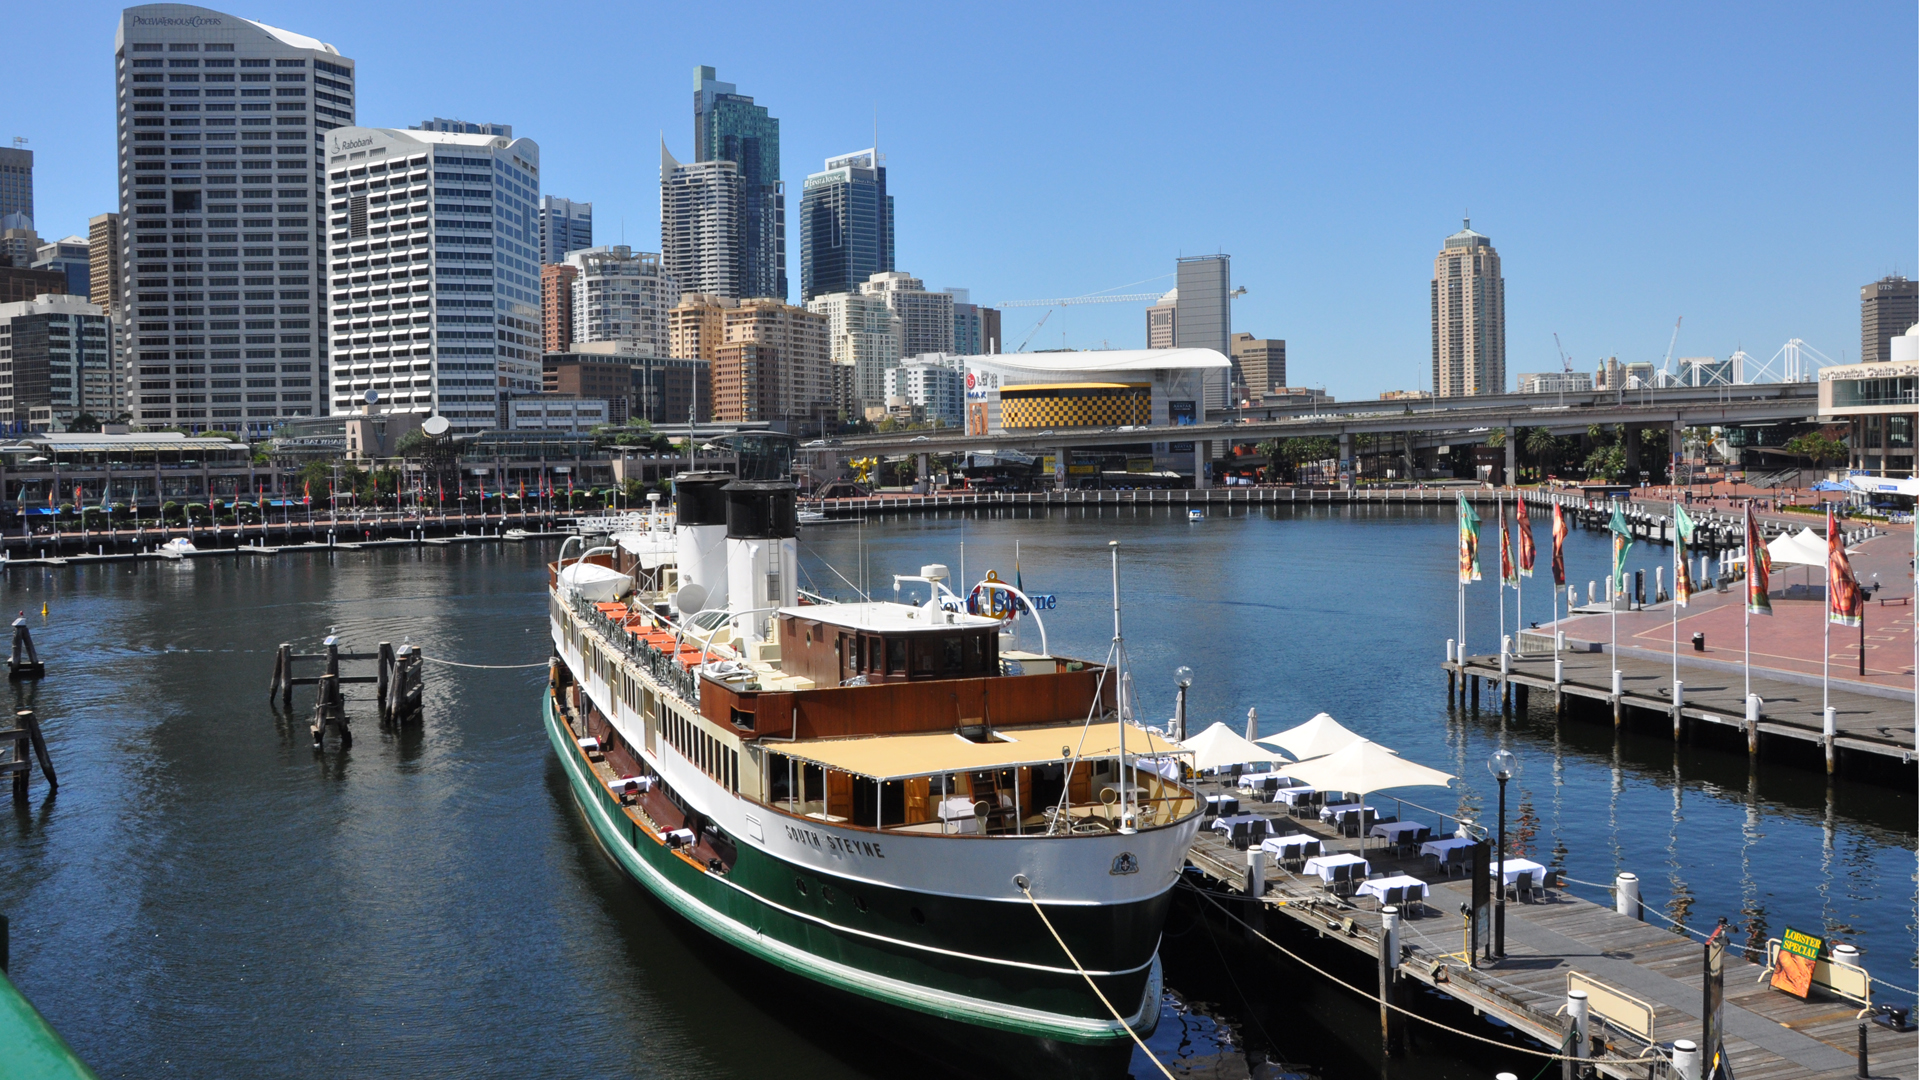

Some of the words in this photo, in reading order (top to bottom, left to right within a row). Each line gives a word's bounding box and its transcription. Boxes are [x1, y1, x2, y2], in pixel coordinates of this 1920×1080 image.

[342, 136, 374, 151] Rabobank
[785, 824, 821, 848] SOUTH
[826, 835, 885, 859] STEYNE
[1785, 928, 1822, 949] LOBSTER
[1783, 940, 1817, 959] SPECIAL
